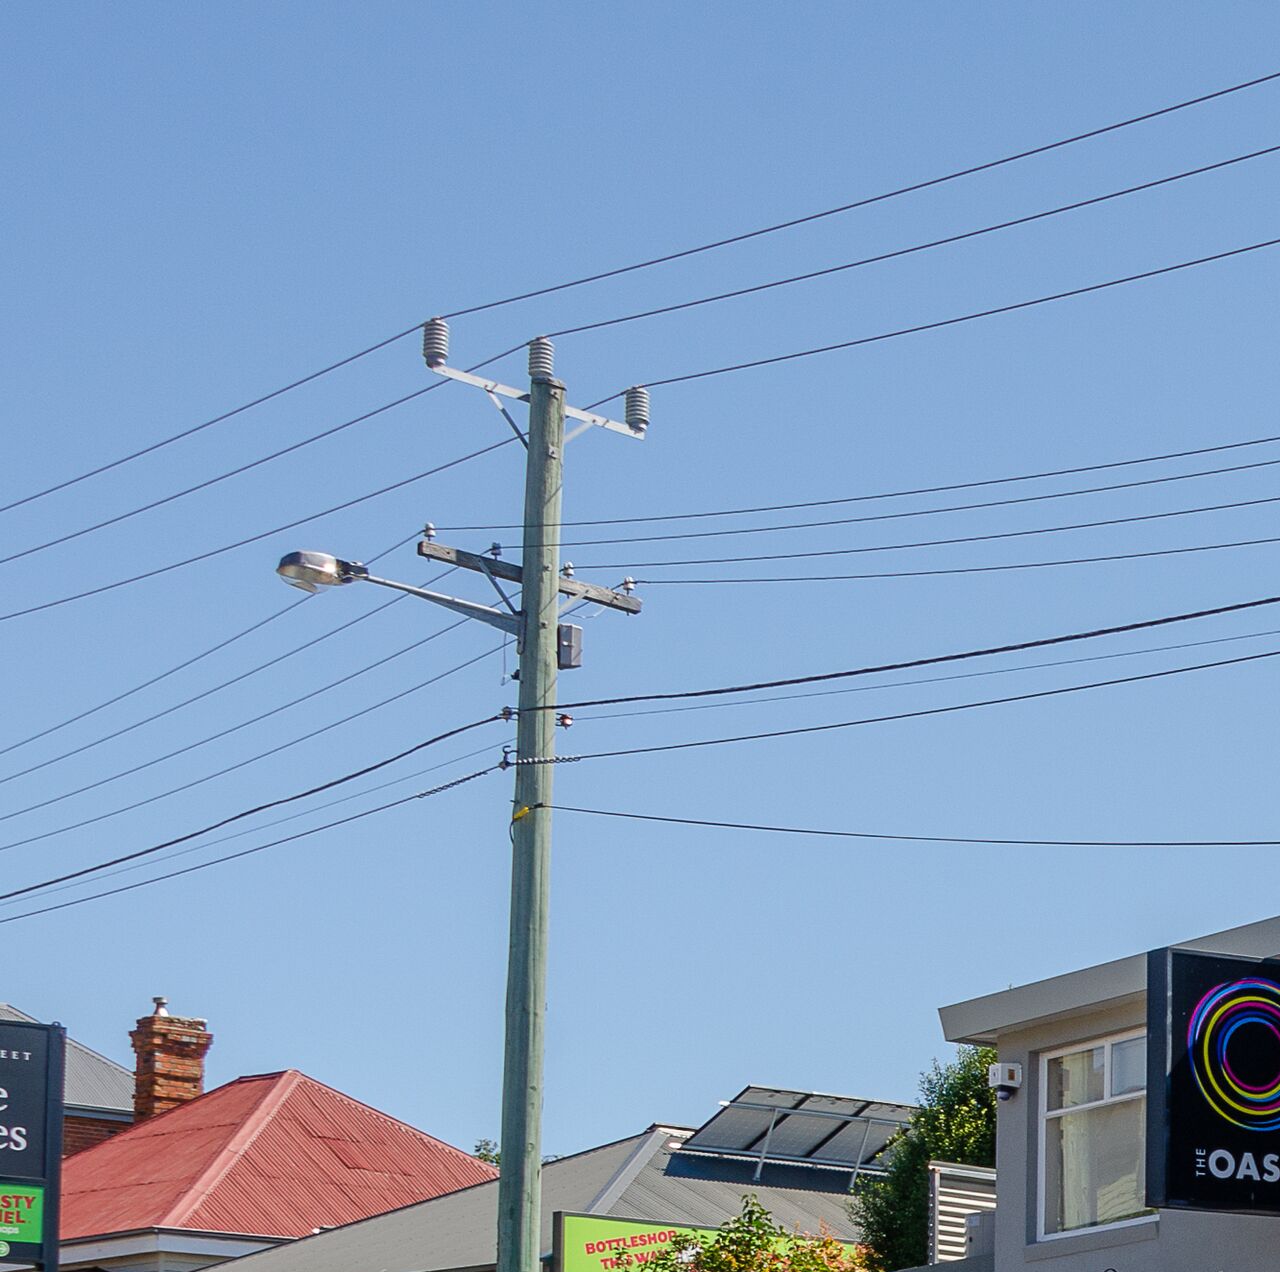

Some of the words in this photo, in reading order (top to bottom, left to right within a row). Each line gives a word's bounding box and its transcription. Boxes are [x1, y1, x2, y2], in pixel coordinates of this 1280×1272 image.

[1195, 1148, 1206, 1177] THE
[585, 1230, 677, 1255] BOTTLESHOP
[600, 1254, 633, 1270] THS
[634, 1249, 666, 1264] WA
